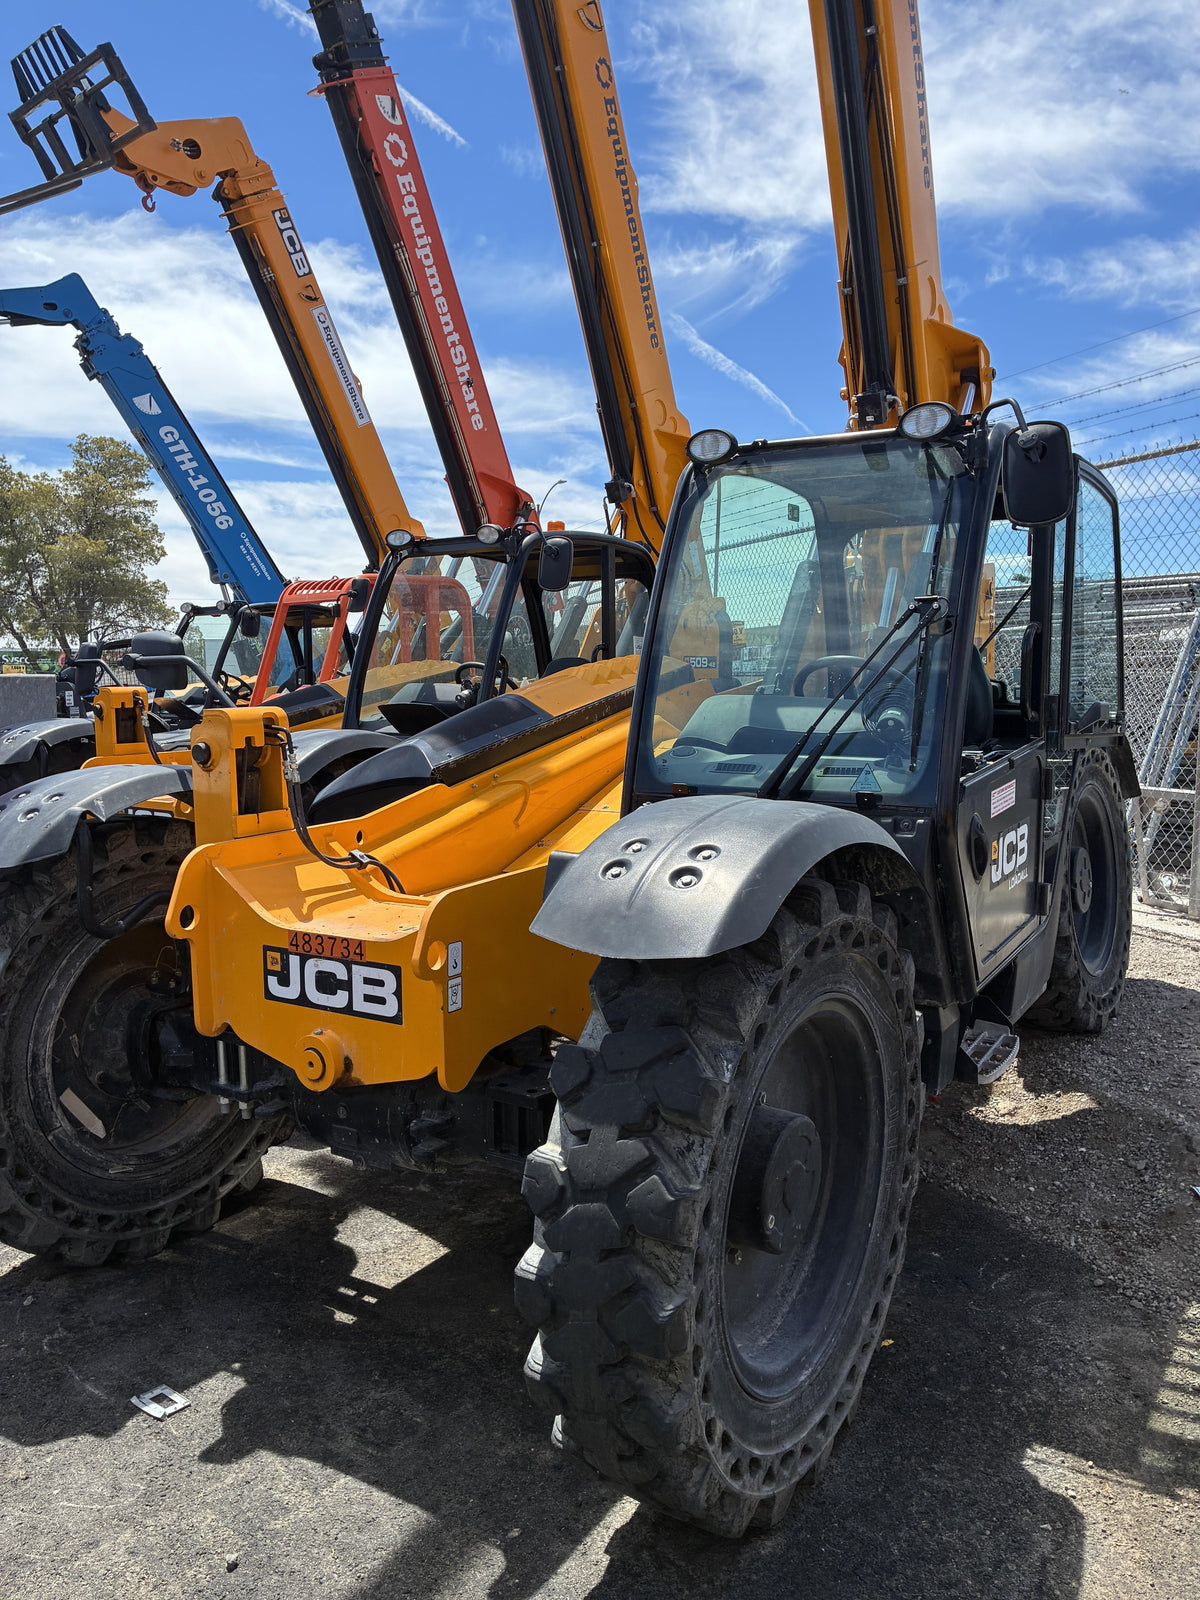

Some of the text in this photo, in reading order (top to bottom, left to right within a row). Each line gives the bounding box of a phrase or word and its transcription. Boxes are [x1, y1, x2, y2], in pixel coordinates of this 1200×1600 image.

[273, 209, 311, 277] JCB
[604, 95, 659, 350] EquipmentShare
[397, 172, 484, 432] EquipmentShare
[323, 326, 364, 420] EquipmentShare
[158, 425, 234, 530] GTH-1056
[991, 823, 1029, 884] JCB
[1008, 867, 1029, 891] LOADALL
[289, 931, 365, 961] 483734
[267, 953, 399, 1018] JCB
